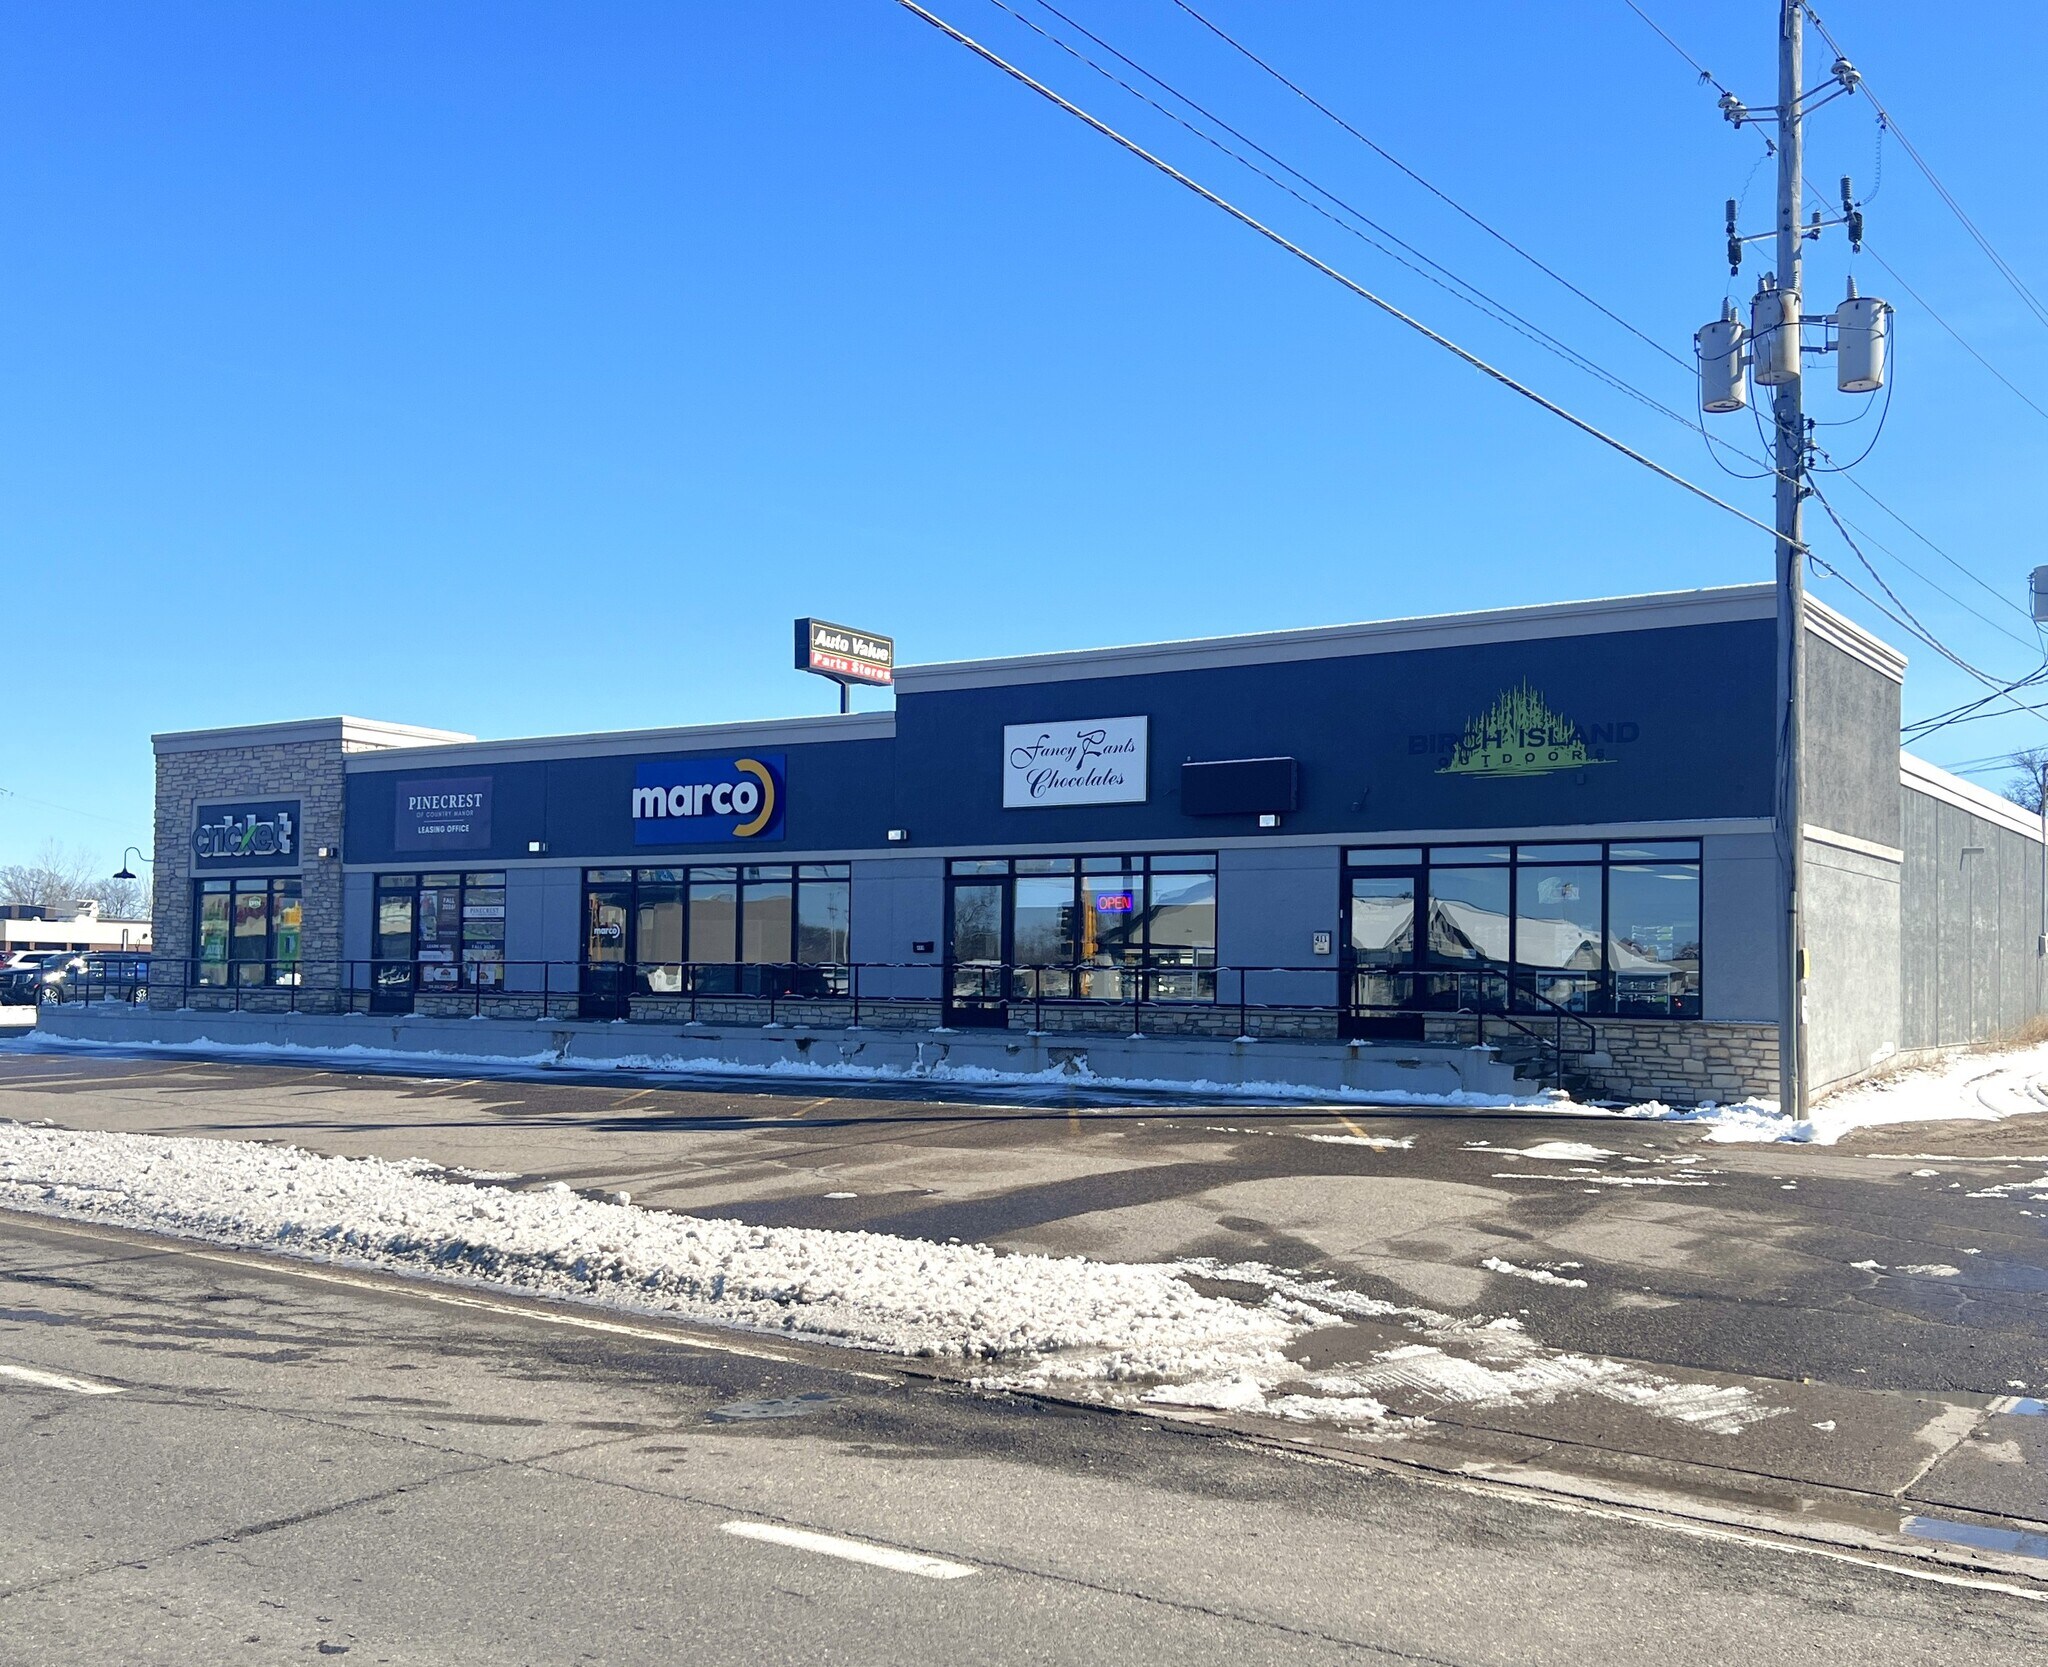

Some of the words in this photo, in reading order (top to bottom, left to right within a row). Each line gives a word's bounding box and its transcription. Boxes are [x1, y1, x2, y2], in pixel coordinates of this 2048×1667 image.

[814, 629, 849, 652] Auto
[852, 637, 889, 661] Value
[813, 652, 848, 671] Parts
[851, 661, 891, 680] Stores
[1010, 734, 1077, 769] Fancy
[1076, 729, 1137, 771] Pants
[1408, 729, 1502, 755] BIRCH
[1519, 721, 1640, 749] ISLAND
[1026, 767, 1125, 798] Chocolates
[408, 793, 483, 810] PINECREST
[425, 810, 452, 818] COUNTRY
[453, 809, 474, 817] MANOR
[632, 781, 759, 819] marco
[192, 813, 292, 857] cricket
[417, 825, 445, 834] LEASING
[446, 824, 470, 833] OFFICE
[1099, 896, 1131, 910] OPEN
[594, 927, 617, 935] marco
[1315, 935, 1327, 943] 411
